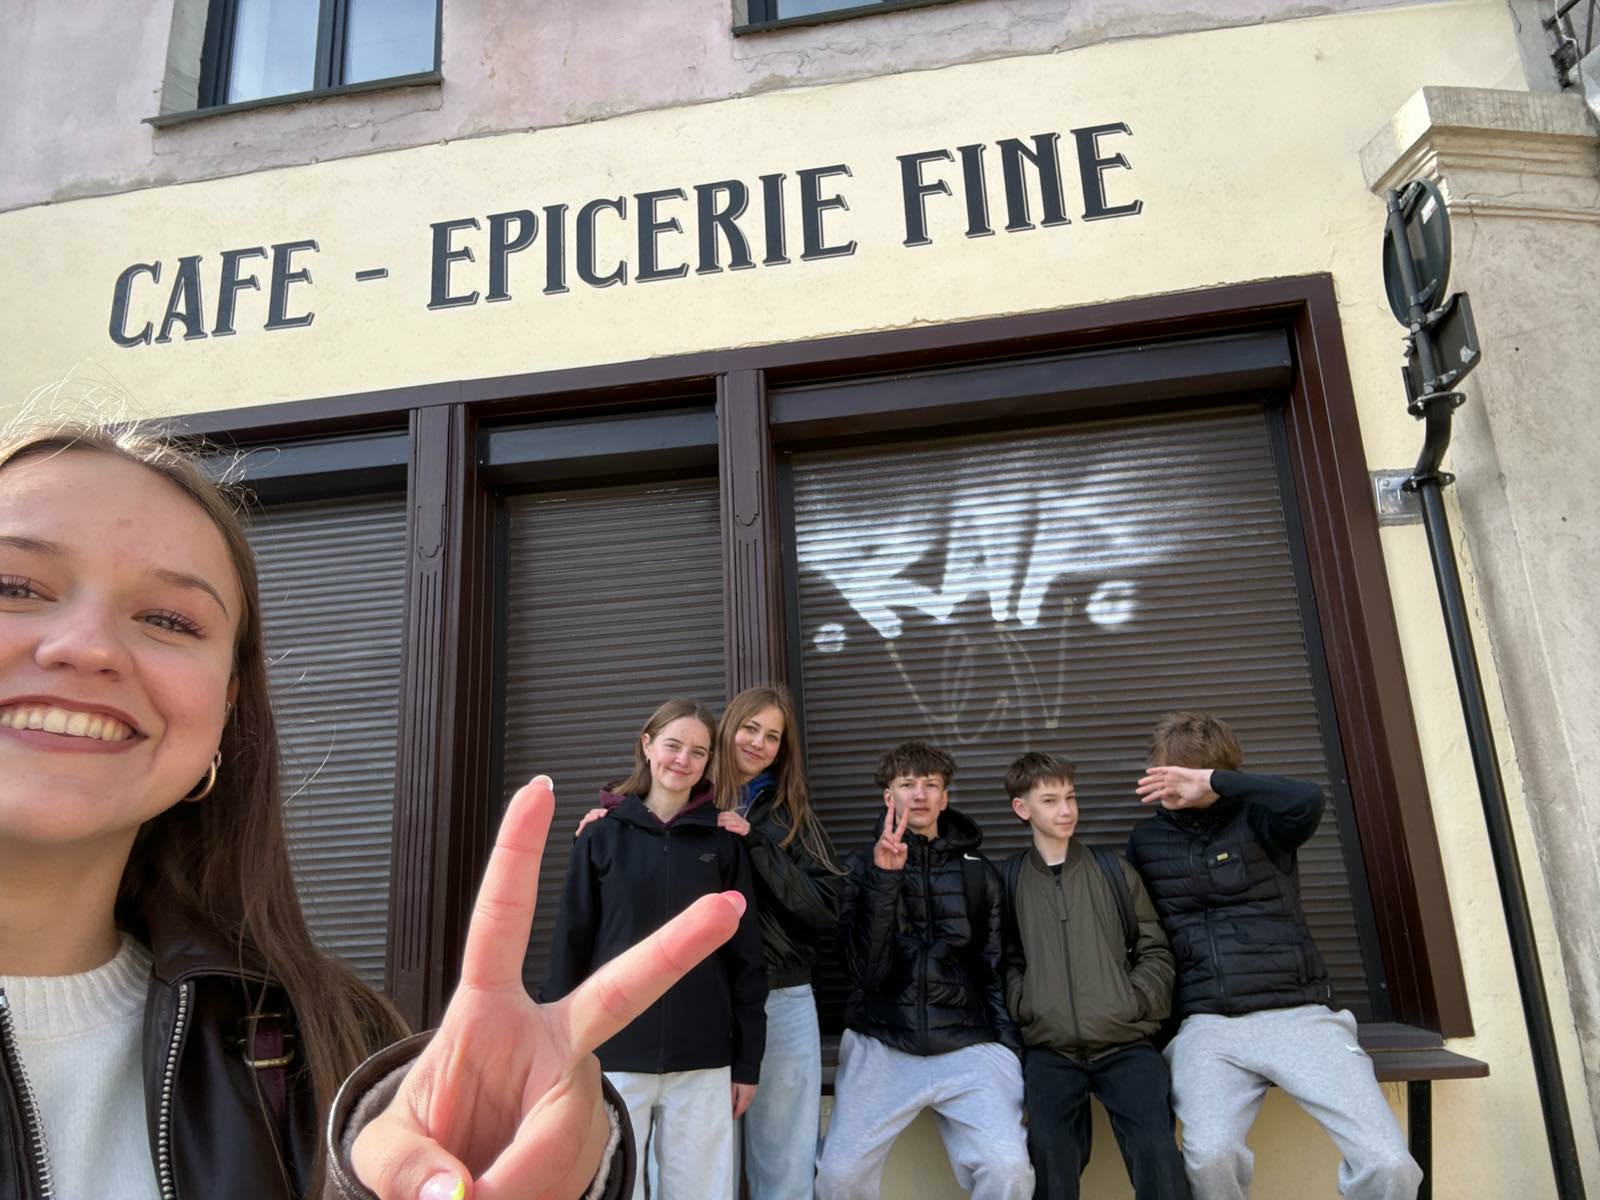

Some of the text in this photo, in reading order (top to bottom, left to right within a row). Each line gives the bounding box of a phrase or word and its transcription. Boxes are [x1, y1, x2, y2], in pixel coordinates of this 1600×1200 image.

[109, 121, 1144, 348] CAFE - EPICERIE FINE
